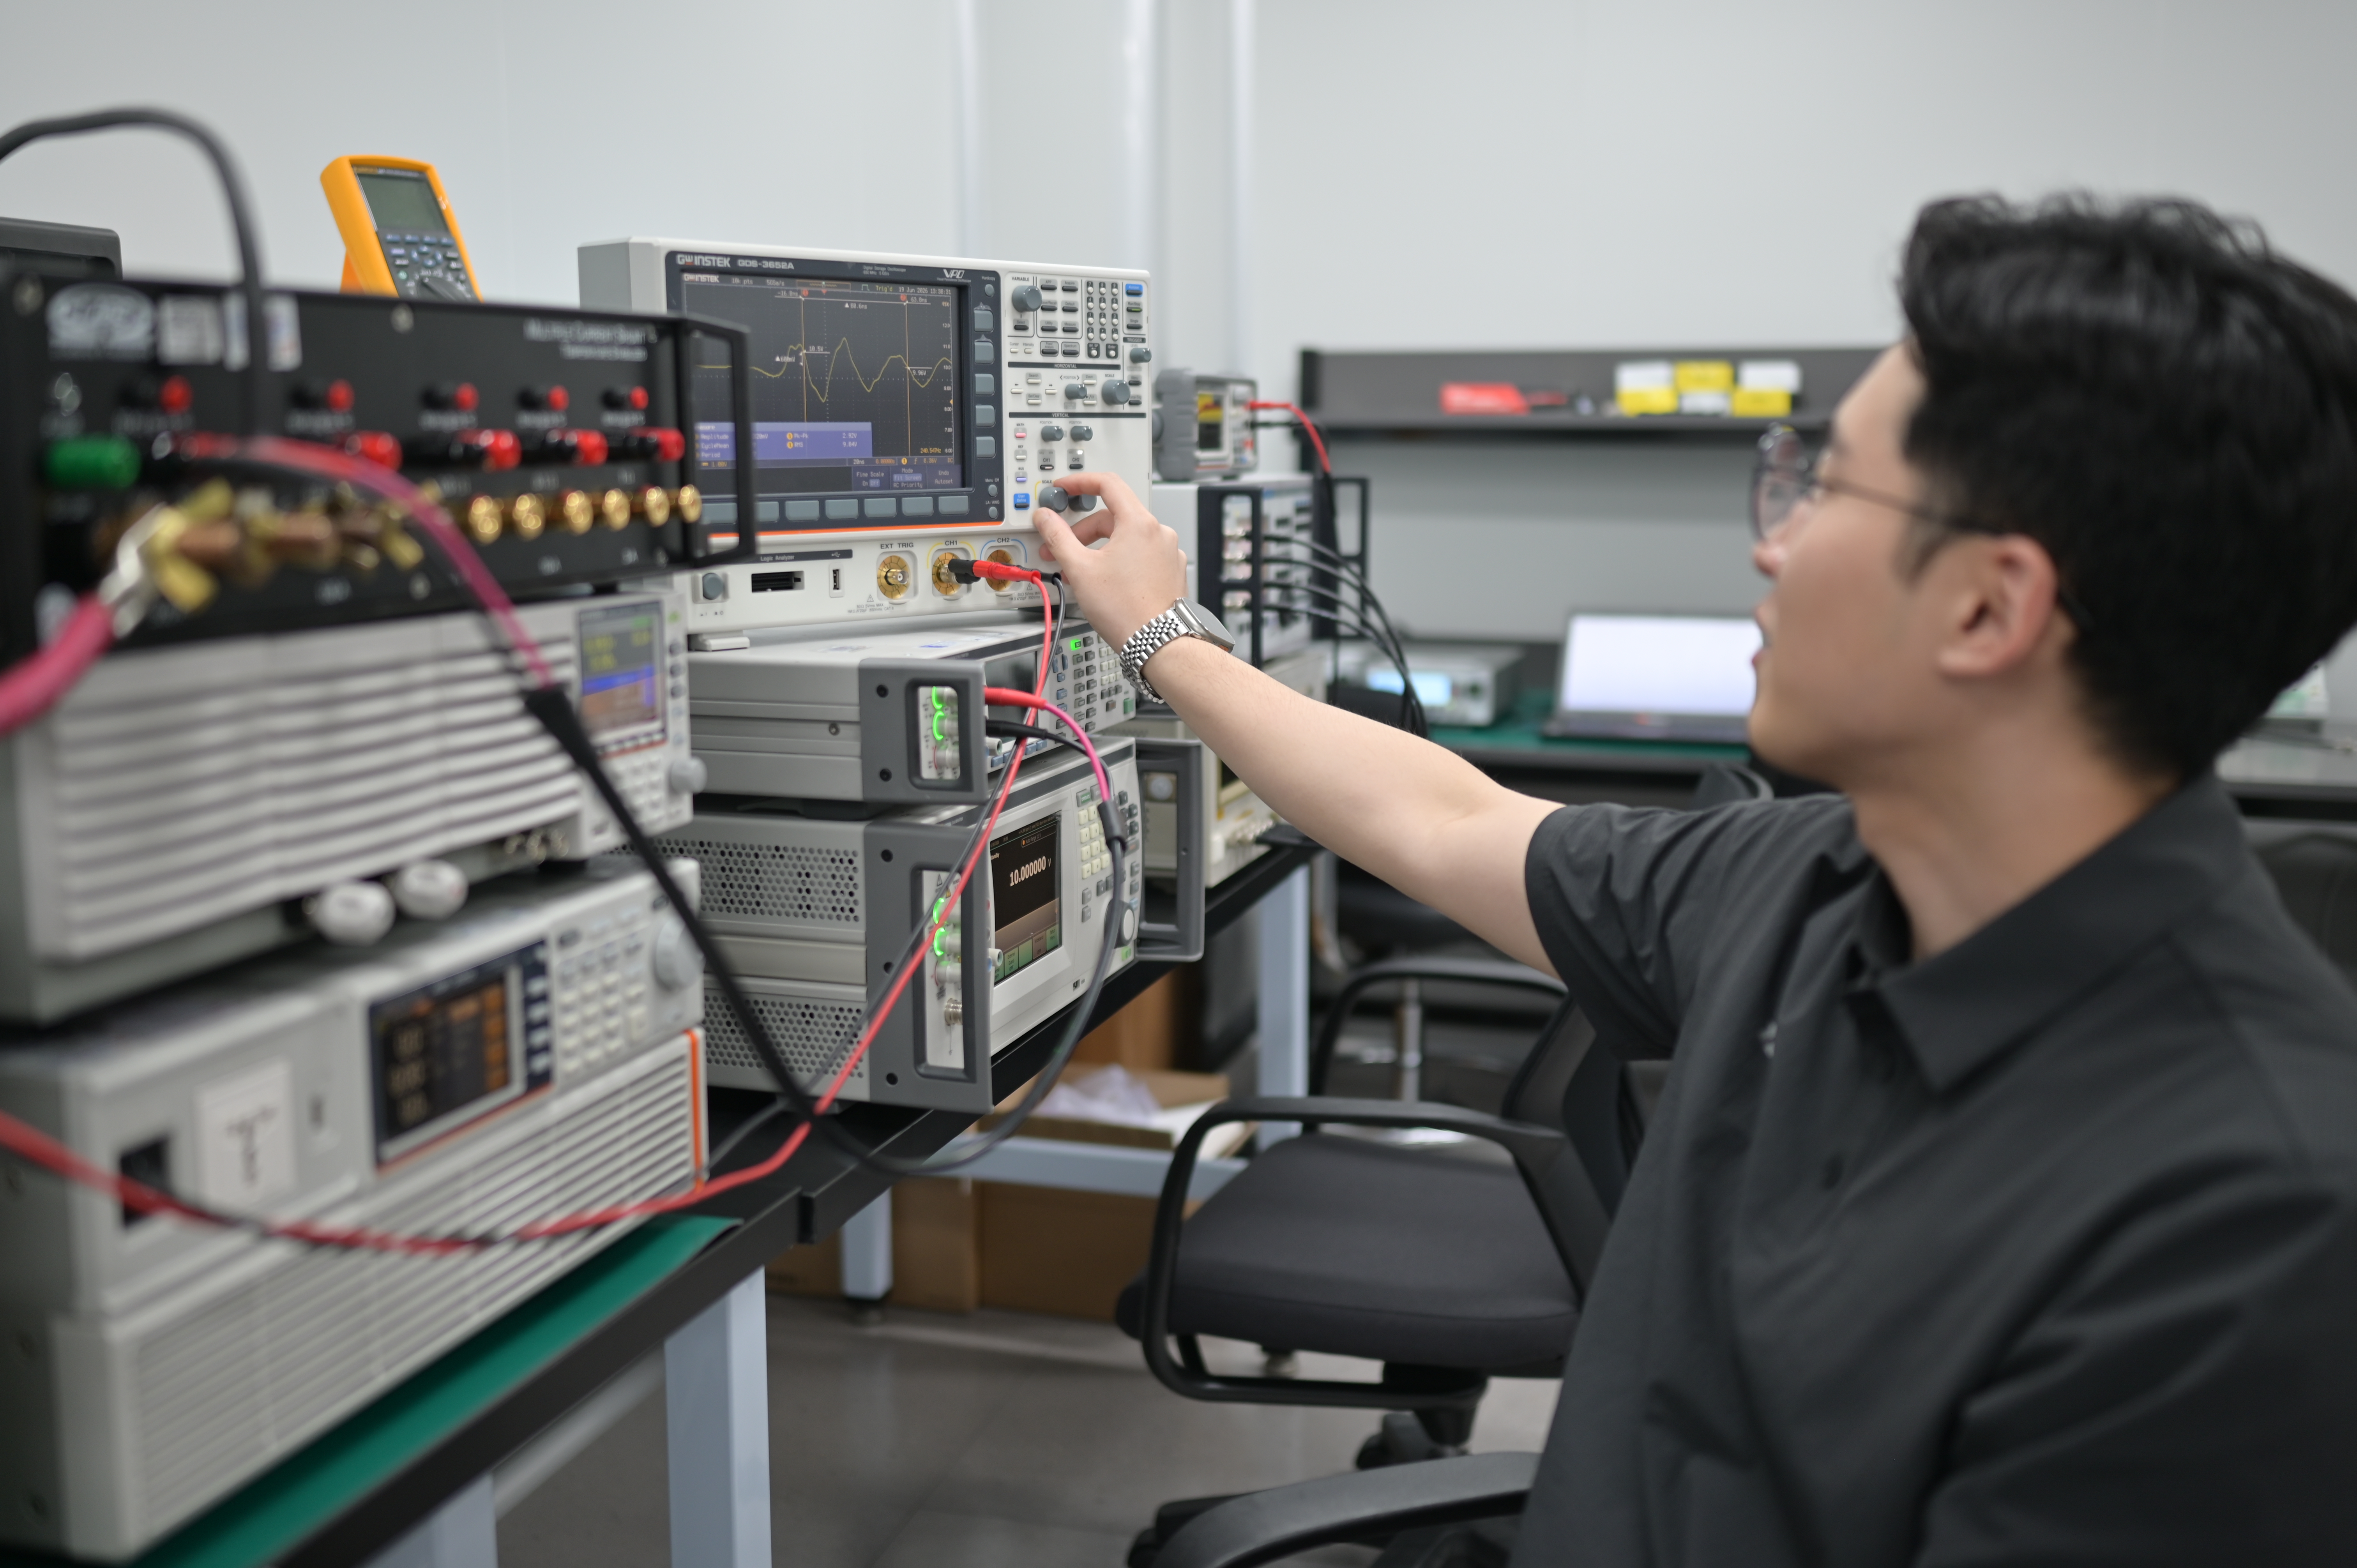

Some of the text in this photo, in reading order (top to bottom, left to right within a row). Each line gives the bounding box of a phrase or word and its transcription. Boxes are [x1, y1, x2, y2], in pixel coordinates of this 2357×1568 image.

[737, 259, 795, 270] GDS-3652A
[943, 269, 965, 279] VPO
[1009, 856, 1051, 887] 10.000000 V
